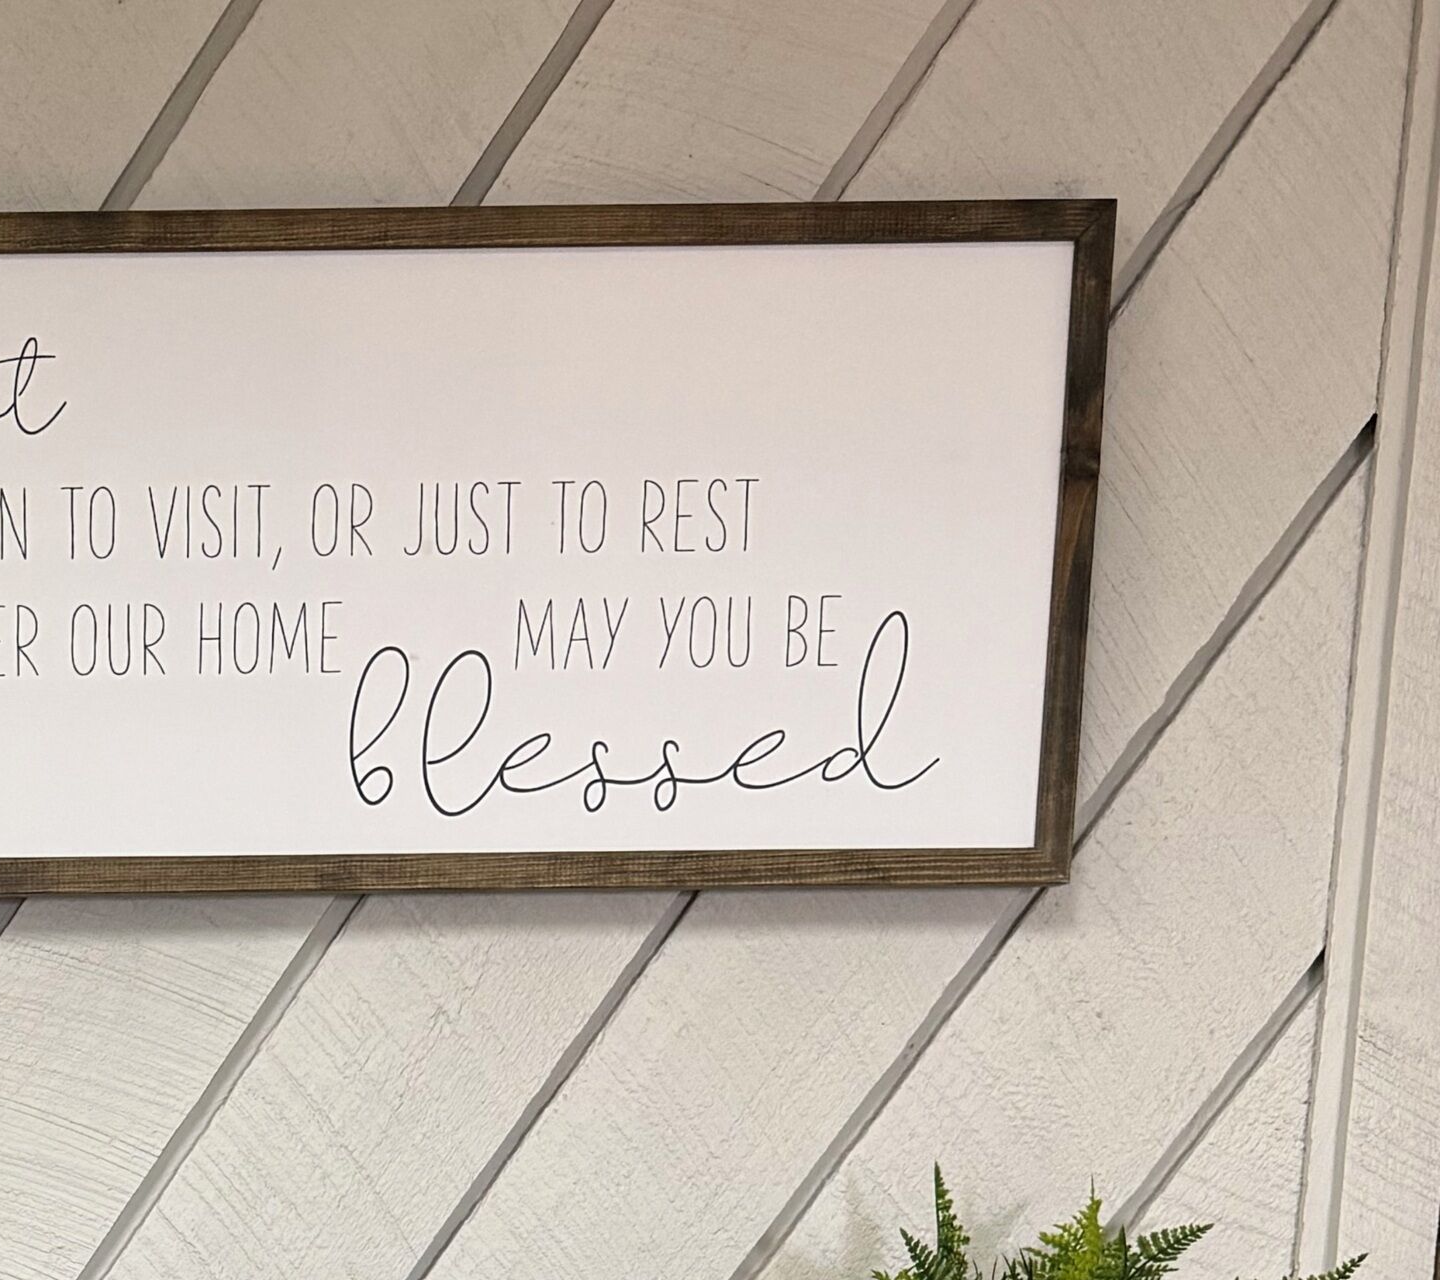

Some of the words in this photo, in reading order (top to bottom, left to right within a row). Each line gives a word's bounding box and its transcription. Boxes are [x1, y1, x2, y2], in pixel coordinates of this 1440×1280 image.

[59, 485, 116, 561] TO
[147, 484, 283, 572] VISIT,
[311, 482, 375, 558] OR
[403, 480, 522, 557] JUST
[551, 479, 608, 555] TO
[641, 478, 760, 554] REST
[70, 602, 167, 677] OUR
[198, 600, 344, 676] HOME
[514, 596, 629, 671] MAY
[658, 595, 752, 670] YOU
[785, 594, 843, 668] BE
[348, 609, 941, 818] blessed
